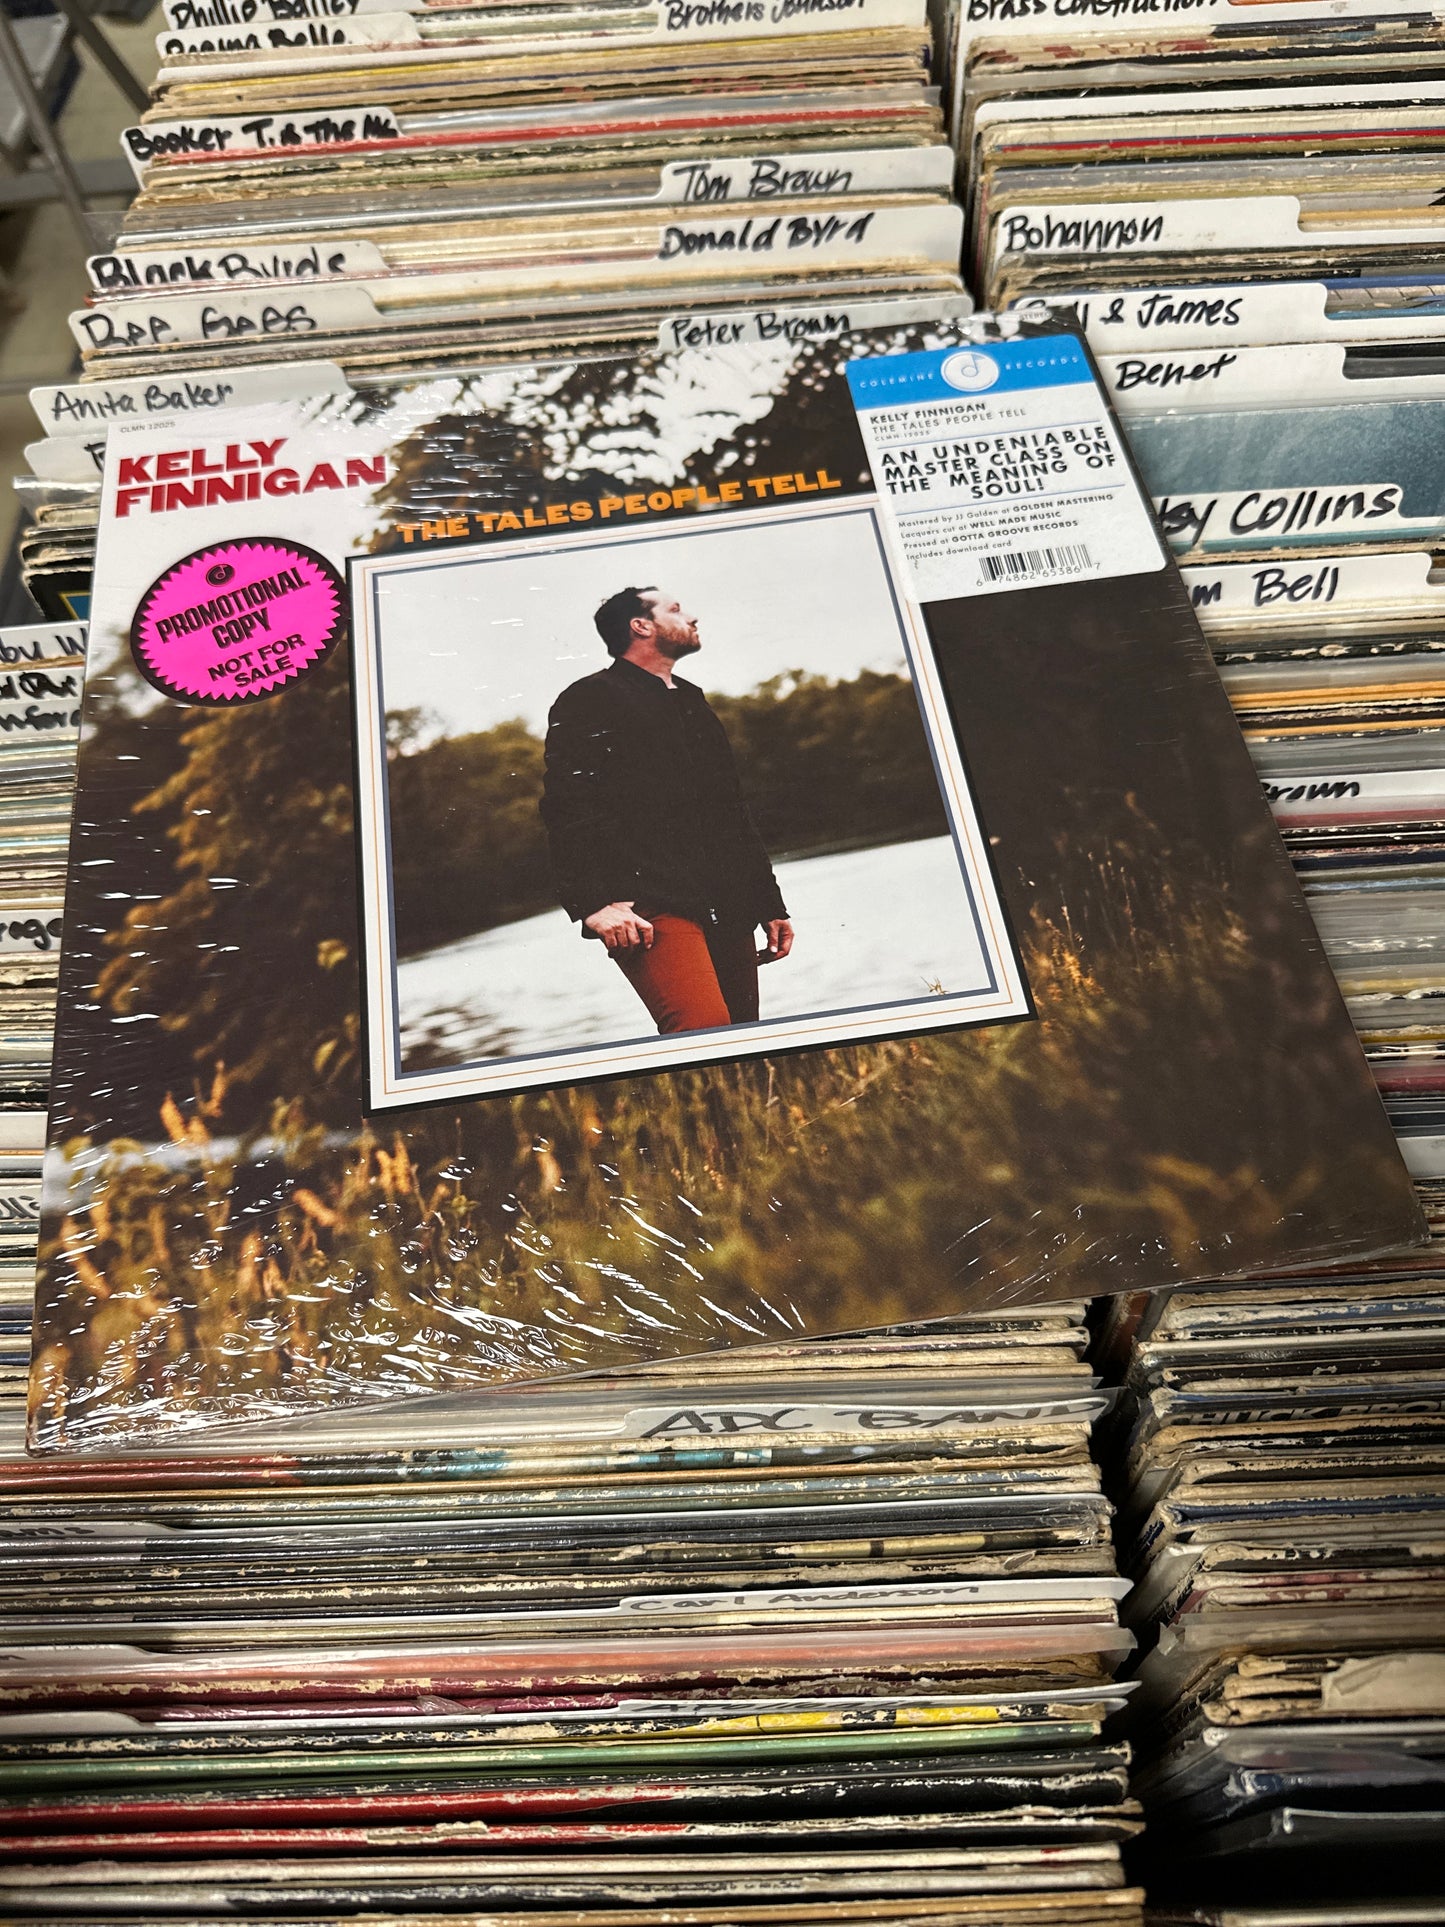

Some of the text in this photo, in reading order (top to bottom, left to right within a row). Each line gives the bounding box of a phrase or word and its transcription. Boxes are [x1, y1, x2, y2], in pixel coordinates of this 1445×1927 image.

[125, 127, 232, 161] Booker
[673, 163, 732, 201] Tom
[658, 211, 875, 260] Donald Byrd
[1001, 214, 1163, 252] Bohannon
[671, 311, 850, 349] Peter Brown
[1099, 298, 1124, 325] &
[1137, 293, 1243, 329] James
[859, 356, 1080, 389] COLEMINE RECORDS
[1114, 353, 1238, 392] Benet
[51, 382, 234, 421] Anita Baker
[870, 402, 987, 425] KELLY FINNIGAN
[120, 424, 146, 434] CLMN
[872, 407, 1027, 435] THE TALES PEOPLE TELL
[118, 437, 289, 487] KELLY
[881, 426, 1108, 467] AN UNDENIABLE
[885, 440, 1112, 481] MASTER CLASS ON
[115, 455, 388, 518] FINNIGAN
[886, 454, 1117, 495] THE MEANING OF
[970, 478, 1046, 499] SOUL!
[396, 470, 842, 544] THE TALES PEOPLE TELL
[898, 516, 939, 528] Mastered
[941, 515, 953, 525] by
[1001, 507, 1010, 515] at
[1013, 501, 1053, 513] GOLDEN
[1056, 494, 1114, 507] MASTERING
[900, 511, 1061, 539] Lacquers cut at WELL MADE MUSIC
[1230, 486, 1399, 536] Collins
[904, 519, 1079, 549] Pressed at GOTTA GROOVE RECORDS
[906, 539, 1012, 561] Includes download card
[155, 567, 311, 644] PROMOTIONAL
[1251, 566, 1340, 607] Bell
[211, 607, 272, 650] COPY
[208, 634, 306, 682] NOT FOR
[234, 655, 295, 688] SALE
[639, 1407, 814, 1439] ADC
[630, 1586, 979, 1612] Carl Anderson
